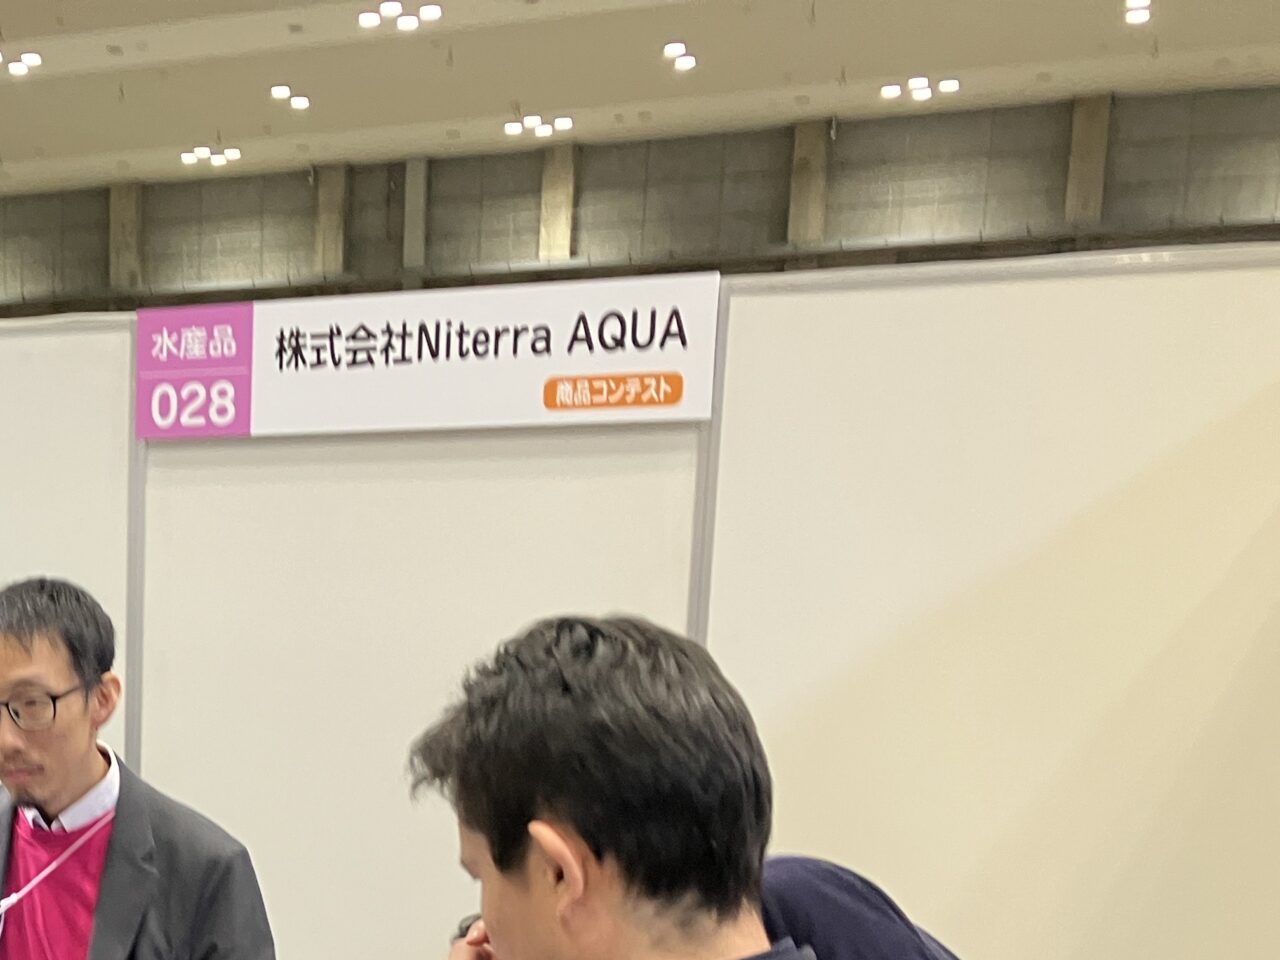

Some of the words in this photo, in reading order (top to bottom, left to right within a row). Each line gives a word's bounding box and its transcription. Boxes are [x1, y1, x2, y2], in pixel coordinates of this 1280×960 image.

[151, 324, 237, 362] 水産品
[275, 320, 552, 372] 株式会社Niterra
[566, 307, 688, 355] AQUA
[150, 379, 236, 429] 028
[556, 375, 672, 408] 商品コンテスト
